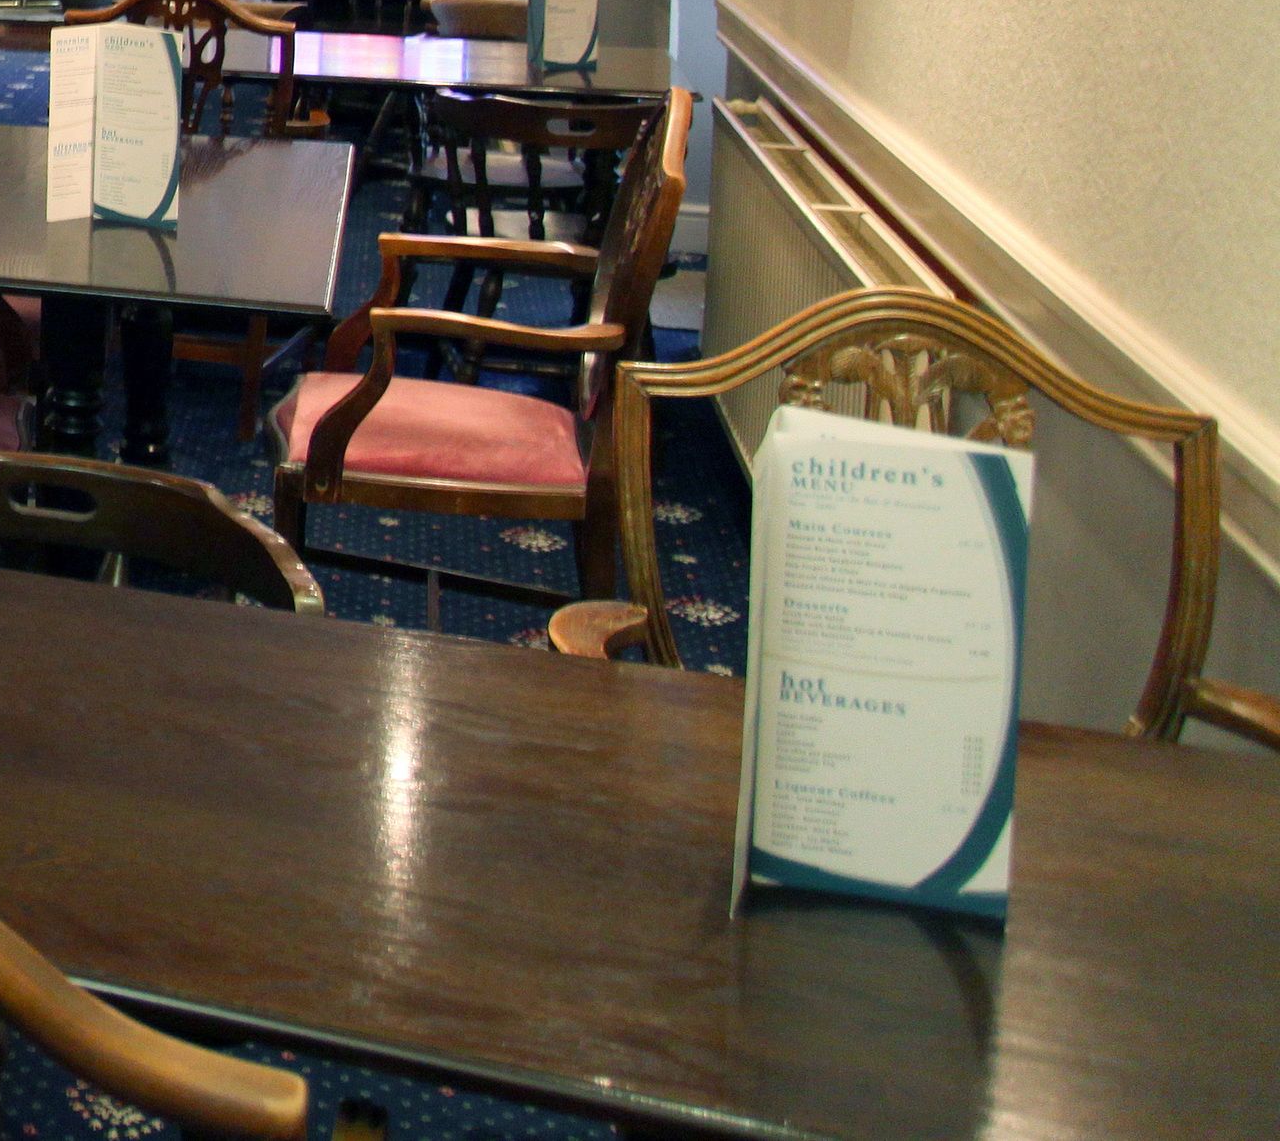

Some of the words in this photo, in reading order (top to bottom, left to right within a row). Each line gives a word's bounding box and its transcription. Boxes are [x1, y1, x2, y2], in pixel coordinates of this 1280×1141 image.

[104, 35, 154, 49] children's
[791, 457, 945, 488] children's
[790, 476, 854, 494] MENU
[789, 519, 826, 533] Main
[781, 670, 825, 692] hot
[779, 689, 906, 716] BEVERAGES
